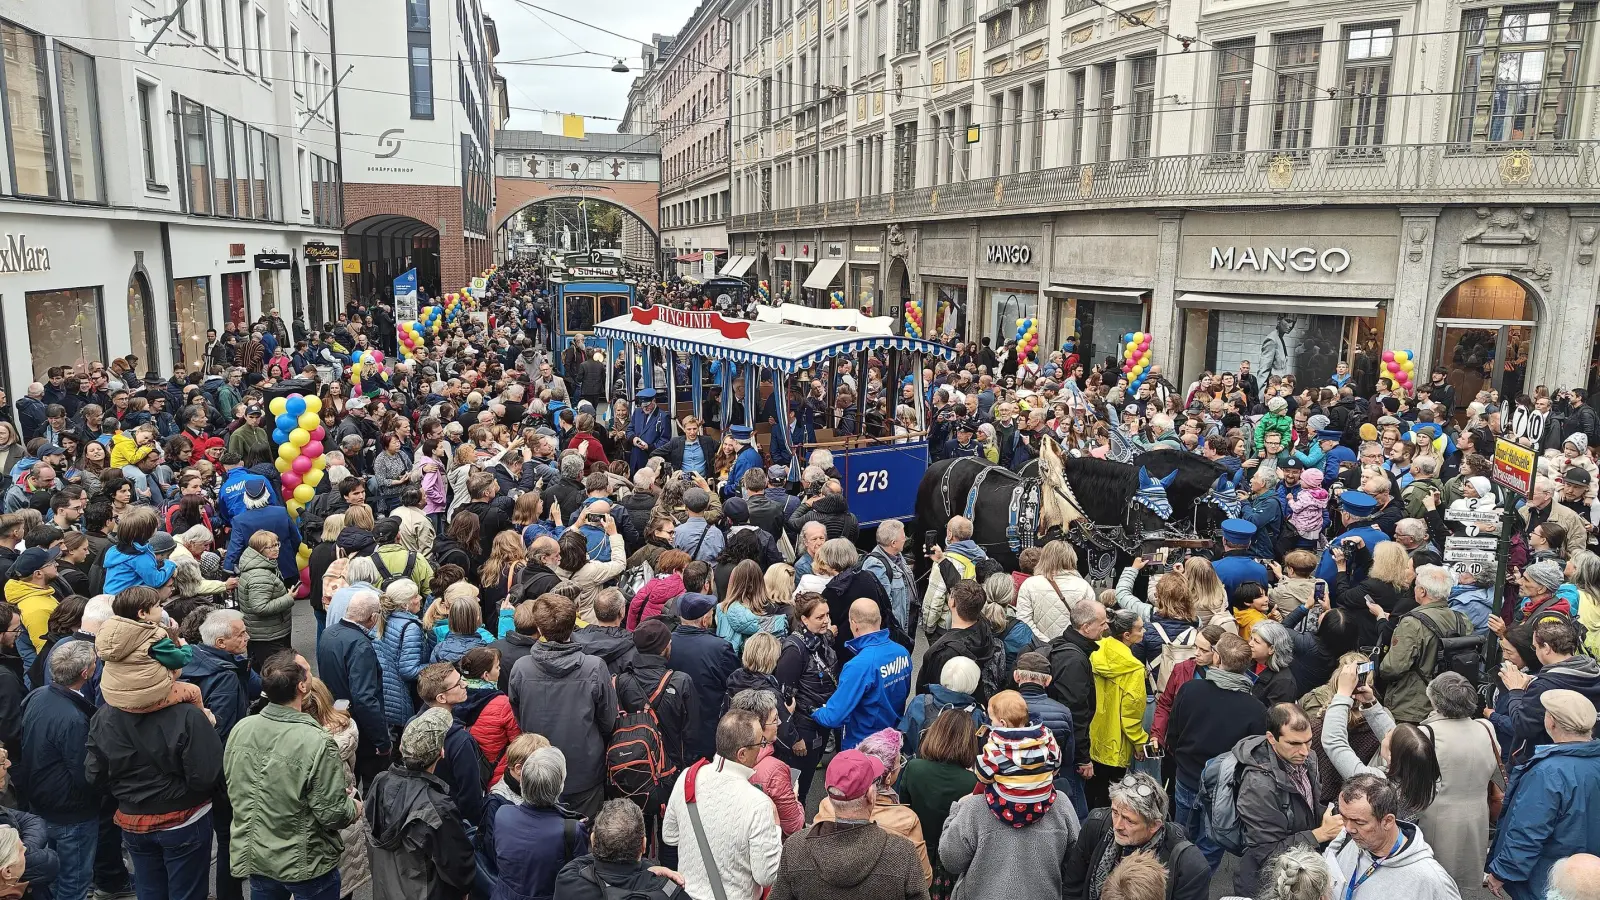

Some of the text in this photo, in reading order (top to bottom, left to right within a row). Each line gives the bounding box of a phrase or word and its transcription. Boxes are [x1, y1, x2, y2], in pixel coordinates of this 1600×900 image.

[590, 252, 600, 264] 12
[986, 244, 1030, 264] MANGO
[1210, 246, 1352, 274] MANGO
[658, 306, 712, 329] RINGLINIE
[1515, 408, 1525, 435] 7
[1529, 412, 1541, 442] 10
[857, 469, 889, 493] 273
[1469, 498, 1478, 510] 2
[1469, 525, 1477, 537] 7
[1455, 563, 1467, 574] 20
[1470, 563, 1481, 575] 10
